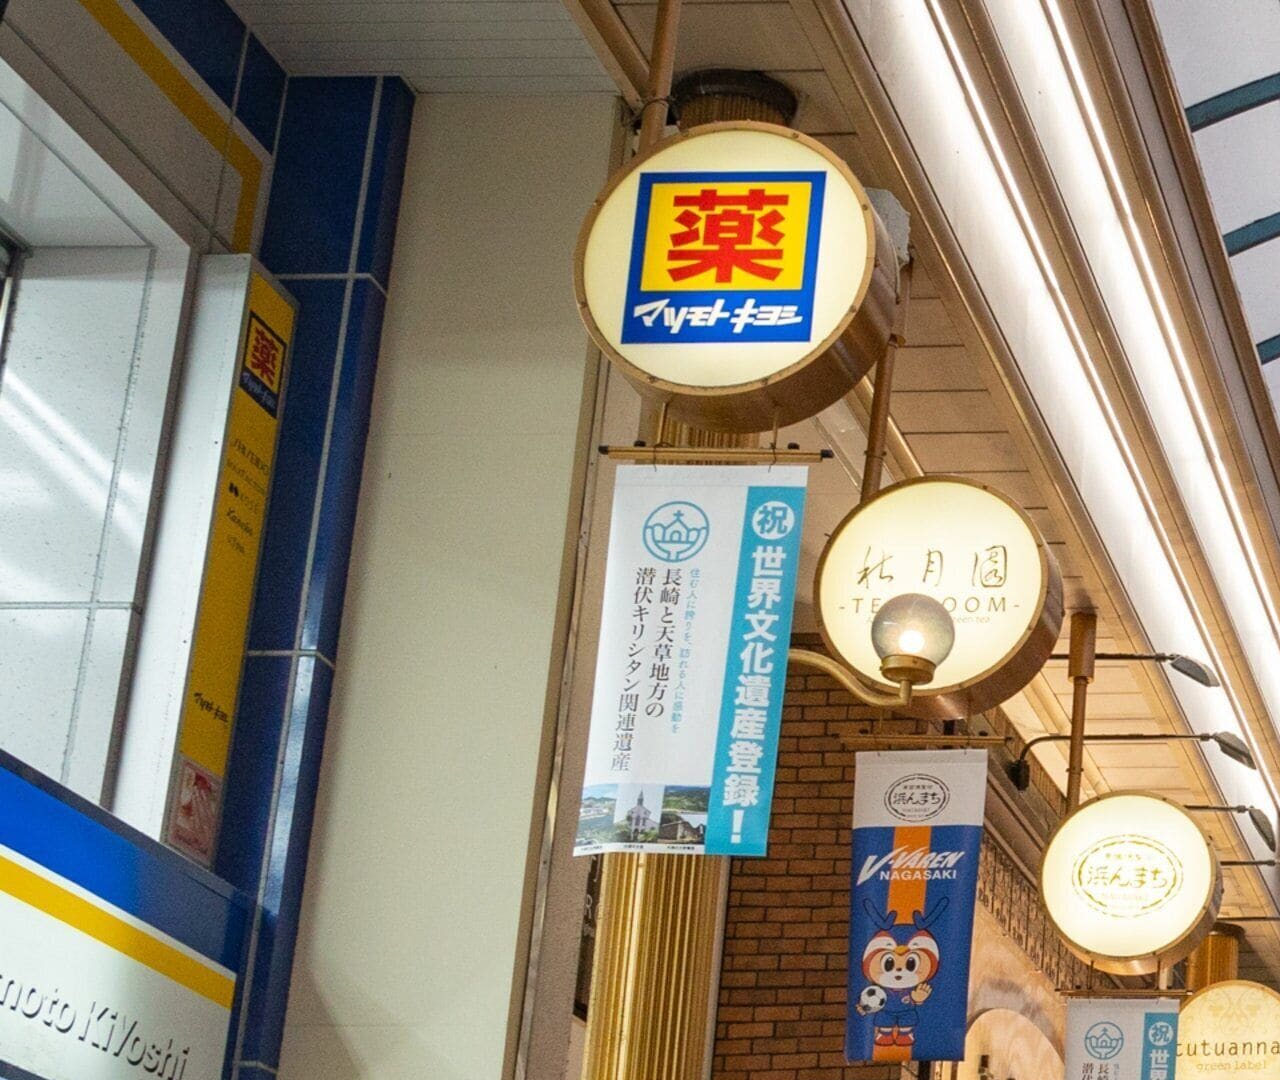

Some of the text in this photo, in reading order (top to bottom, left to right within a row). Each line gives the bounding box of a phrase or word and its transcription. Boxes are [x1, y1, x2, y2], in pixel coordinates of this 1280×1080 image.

[667, 189, 790, 284] 薬
[633, 298, 804, 334] マツモトキヨシ
[610, 566, 657, 772] 潜伏キリシタン関連遺産
[645, 567, 683, 719] 長崎と天草地方の
[880, 869, 957, 880] NAGASAKI
